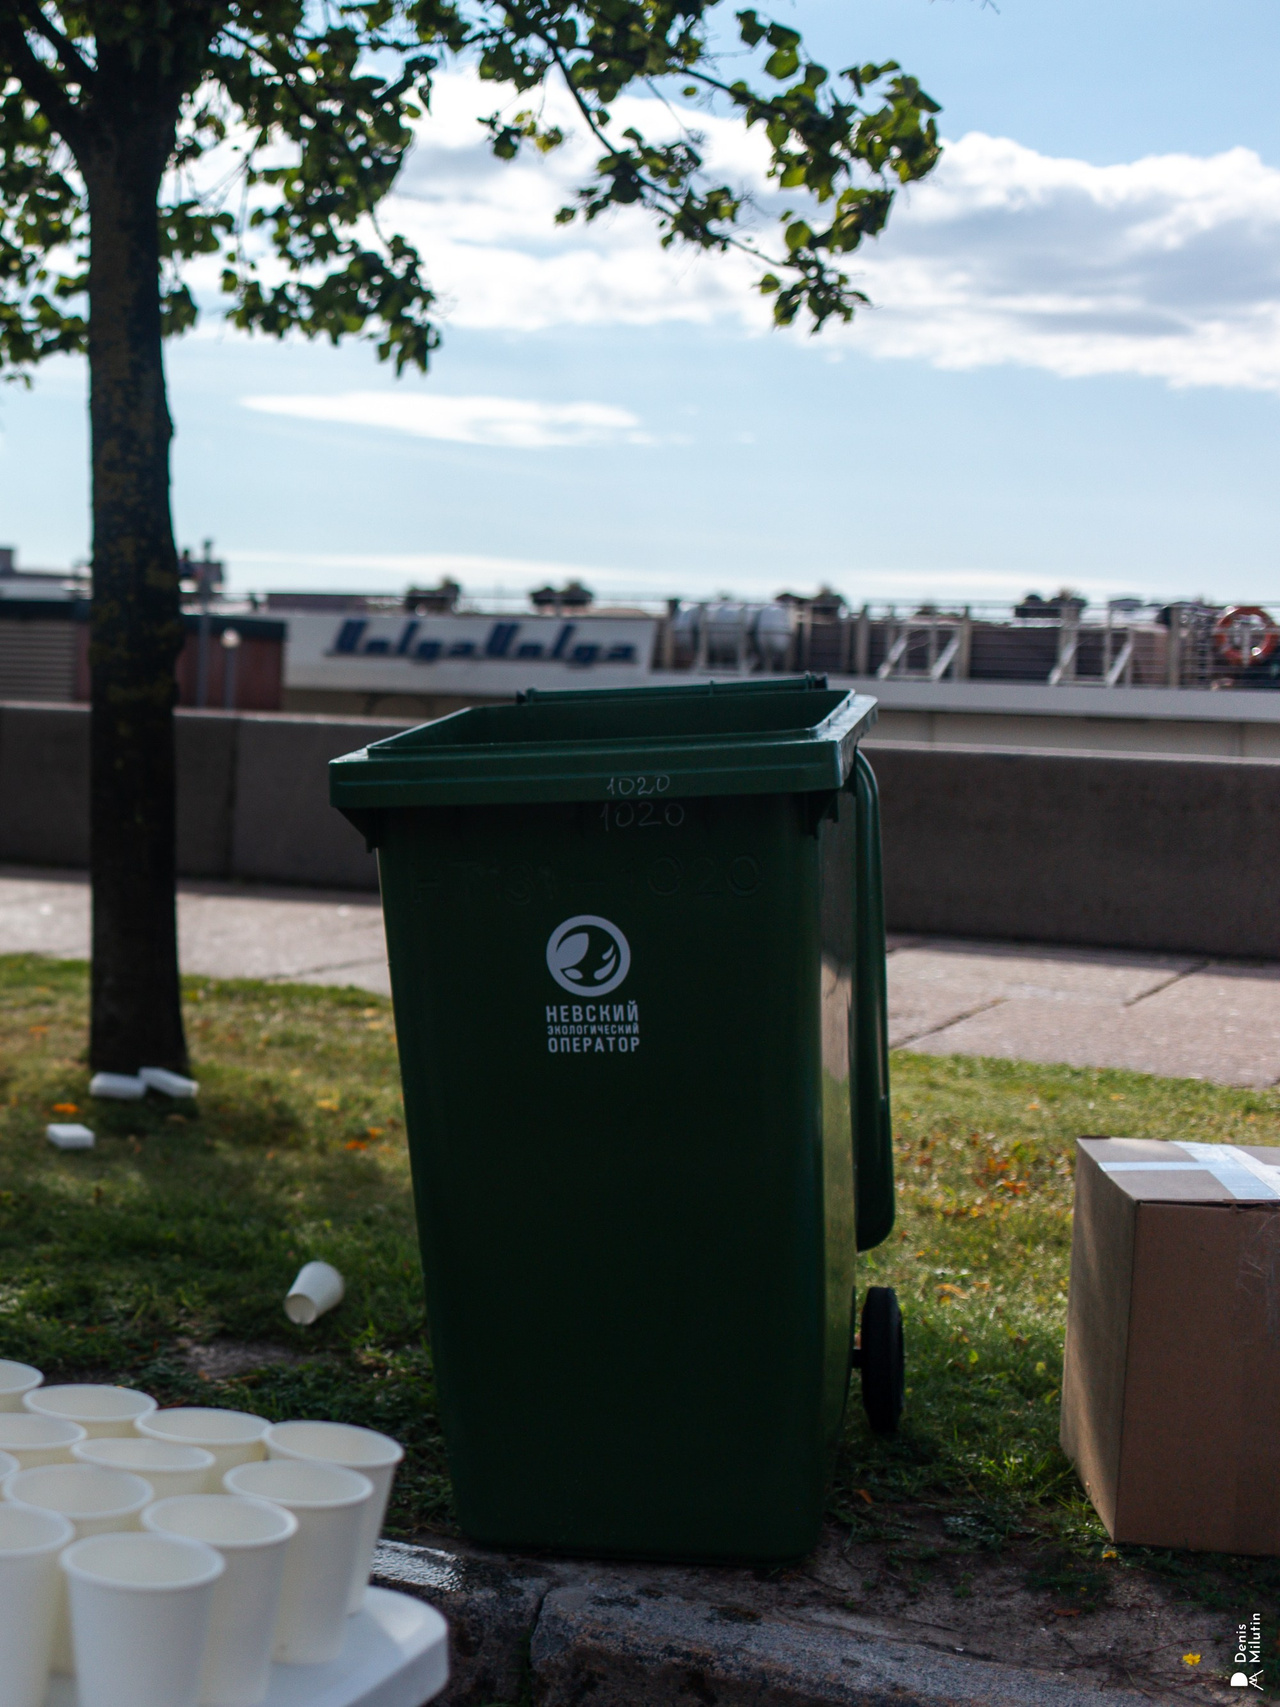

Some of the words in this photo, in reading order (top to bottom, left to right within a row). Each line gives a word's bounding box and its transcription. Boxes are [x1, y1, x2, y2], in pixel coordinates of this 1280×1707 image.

[606, 774, 671, 796] 1020
[599, 801, 685, 832] 1020
[545, 1000, 639, 1022] НЕВСКИЙ
[547, 1023, 640, 1036] ЭКОЛОГИЧЕСКИЙ
[548, 1036, 641, 1053] ОПЕРАТОР
